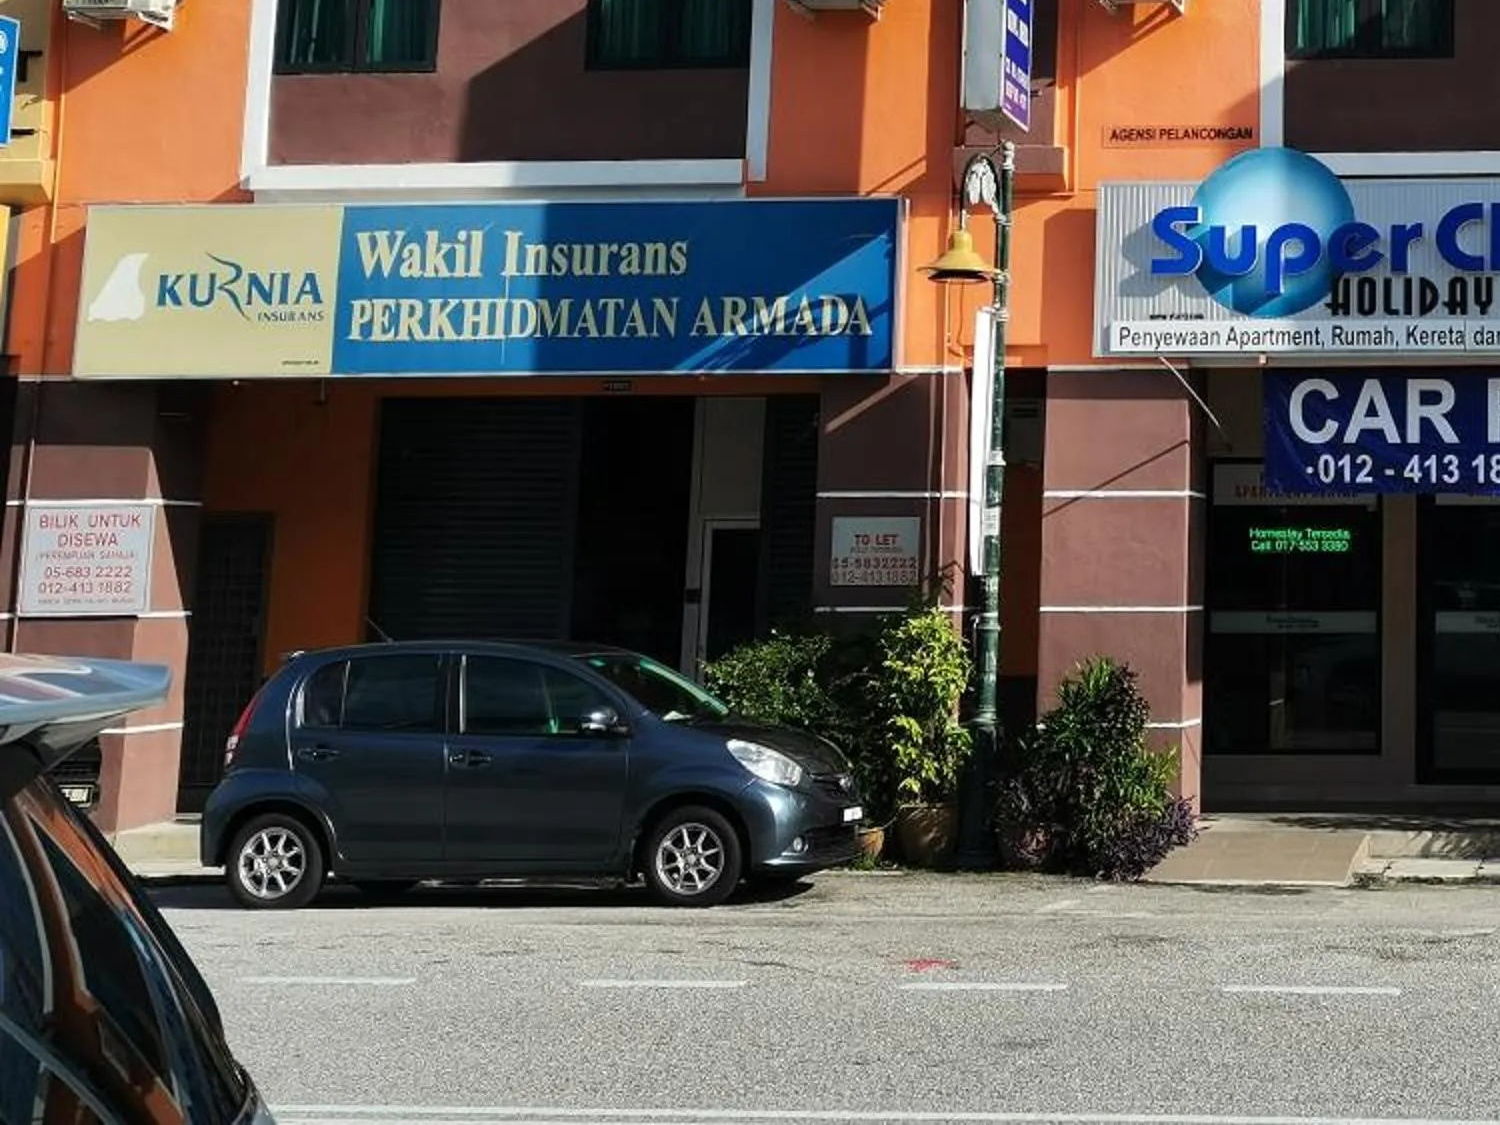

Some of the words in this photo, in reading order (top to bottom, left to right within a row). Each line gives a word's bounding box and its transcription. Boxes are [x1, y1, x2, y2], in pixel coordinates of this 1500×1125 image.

[1109, 128, 1156, 141] AGENSI
[1159, 127, 1253, 140] PELANCONGAN
[356, 230, 483, 279] Wakil
[501, 230, 689, 279] Insurans
[157, 252, 323, 321] KURNIA
[1325, 277, 1493, 316] HOLIDAY
[258, 311, 324, 322] INSURANS
[347, 297, 680, 342] PERKHIDMATAN
[690, 295, 873, 337] ARMADA
[1118, 325, 1221, 349] Penyewaan
[1225, 325, 1326, 349] Apartment,
[1330, 325, 1400, 349] Rumah,
[1405, 324, 1466, 346] Kereta
[1288, 377, 1456, 445] CAR
[1403, 453, 1460, 484] 413
[39, 514, 79, 528] BILIK
[88, 514, 141, 528] UNTUK
[57, 533, 118, 547] DISEWA
[854, 534, 870, 545] TO
[875, 534, 899, 545] LET
[95, 565, 133, 578] 2222
